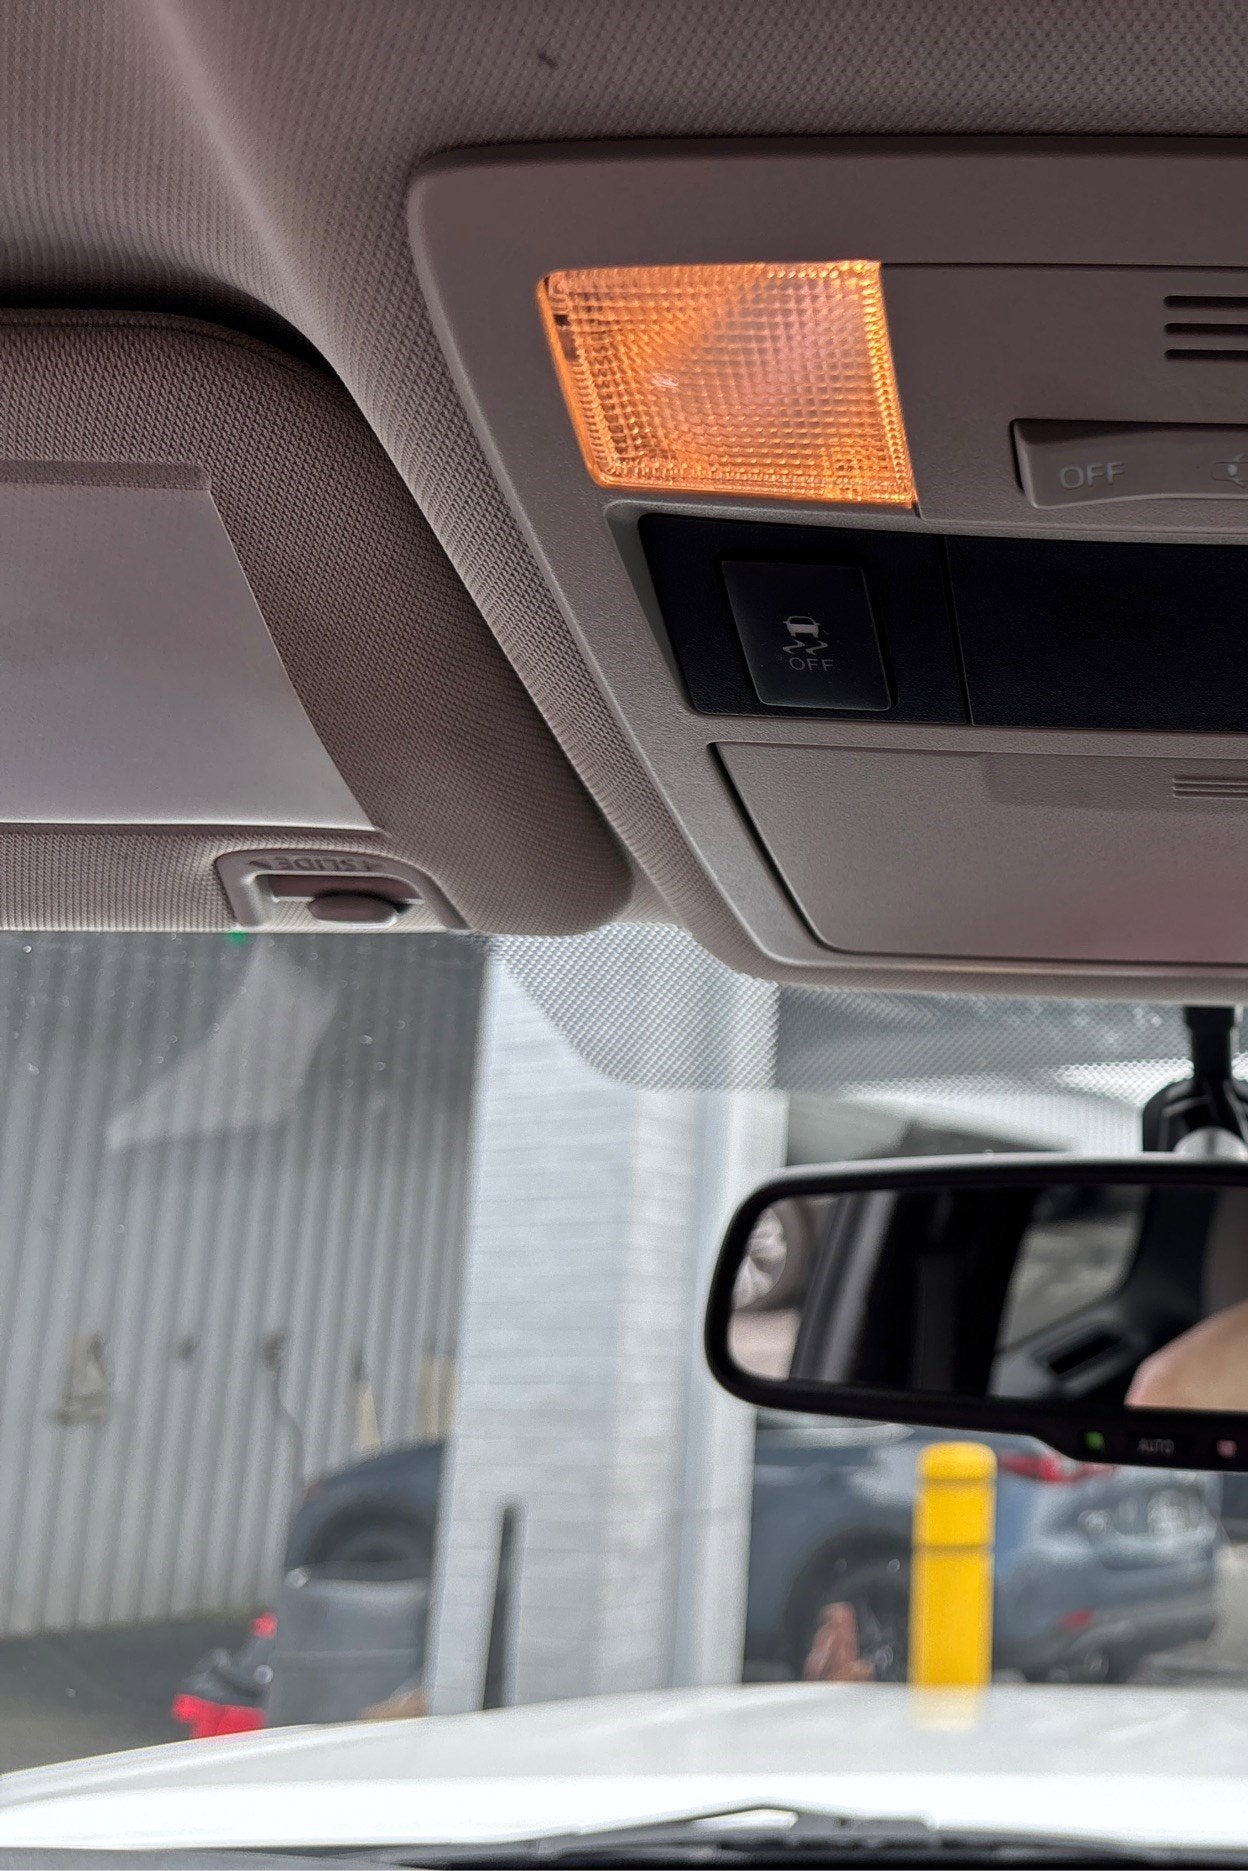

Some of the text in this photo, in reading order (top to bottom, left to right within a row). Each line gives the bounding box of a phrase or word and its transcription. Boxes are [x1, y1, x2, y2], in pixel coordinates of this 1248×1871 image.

[1058, 460, 1126, 490] OFF
[789, 657, 834, 672] OFF
[274, 856, 357, 872] SLIDE
[1137, 1438, 1175, 1457] AUTO
